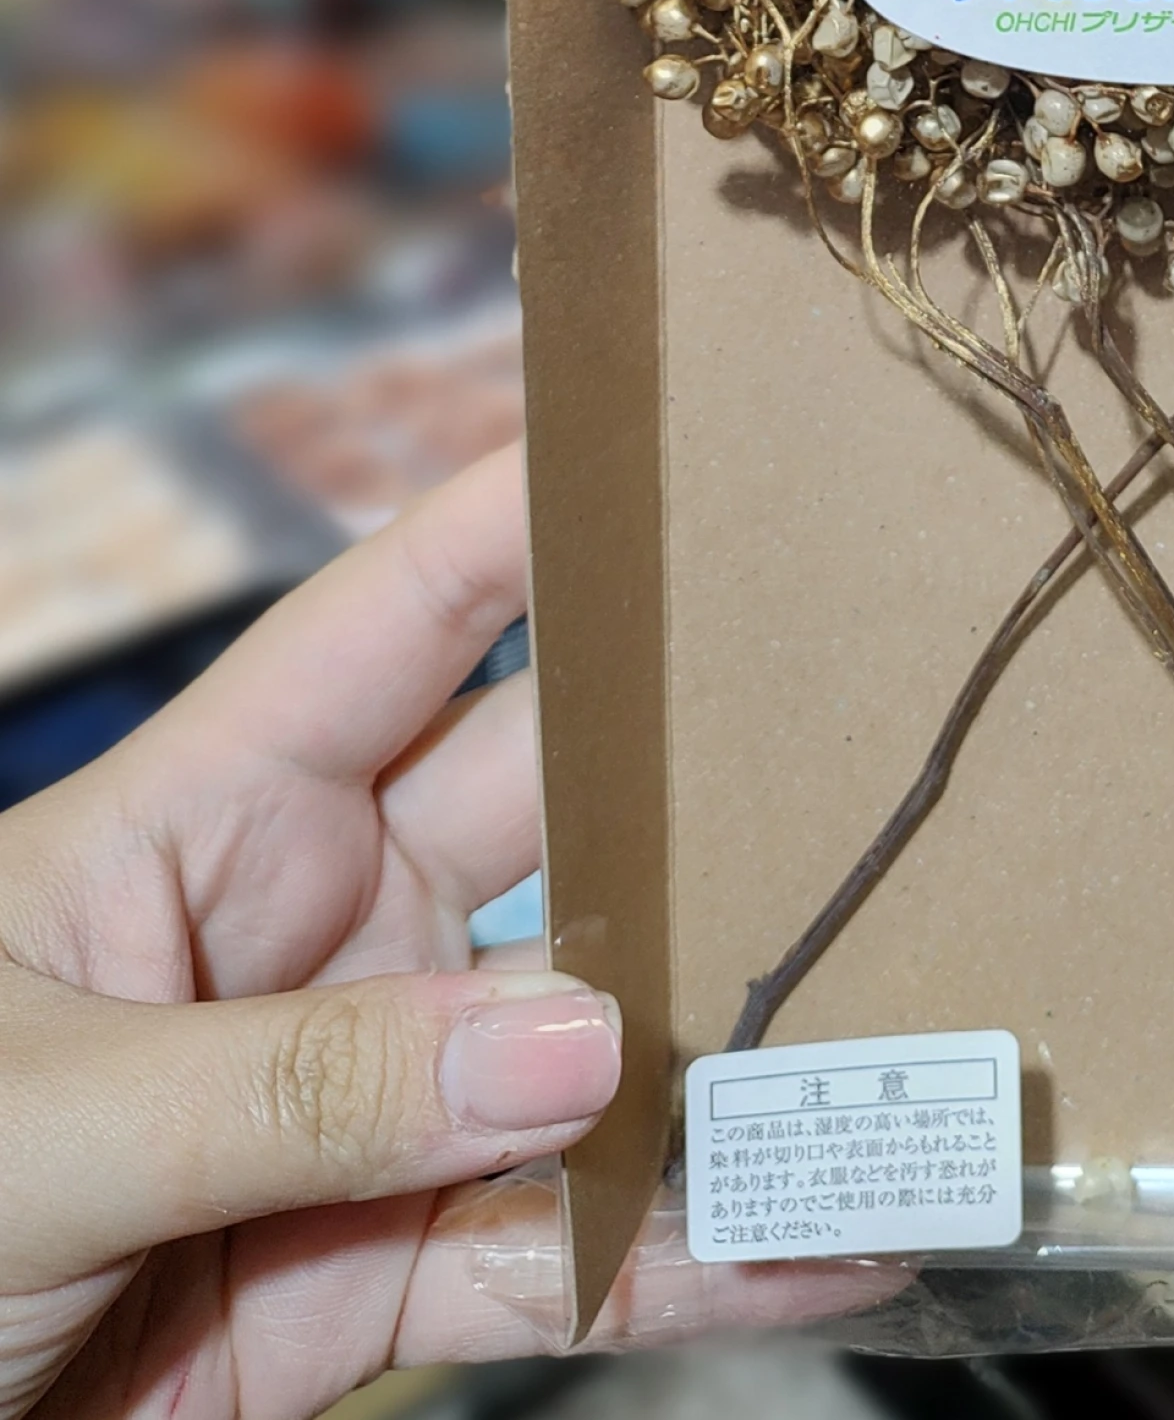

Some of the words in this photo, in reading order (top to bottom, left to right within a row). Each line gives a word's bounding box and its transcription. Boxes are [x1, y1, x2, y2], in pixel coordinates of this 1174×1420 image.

[711, 1221, 843, 1244] ご注意ください。
